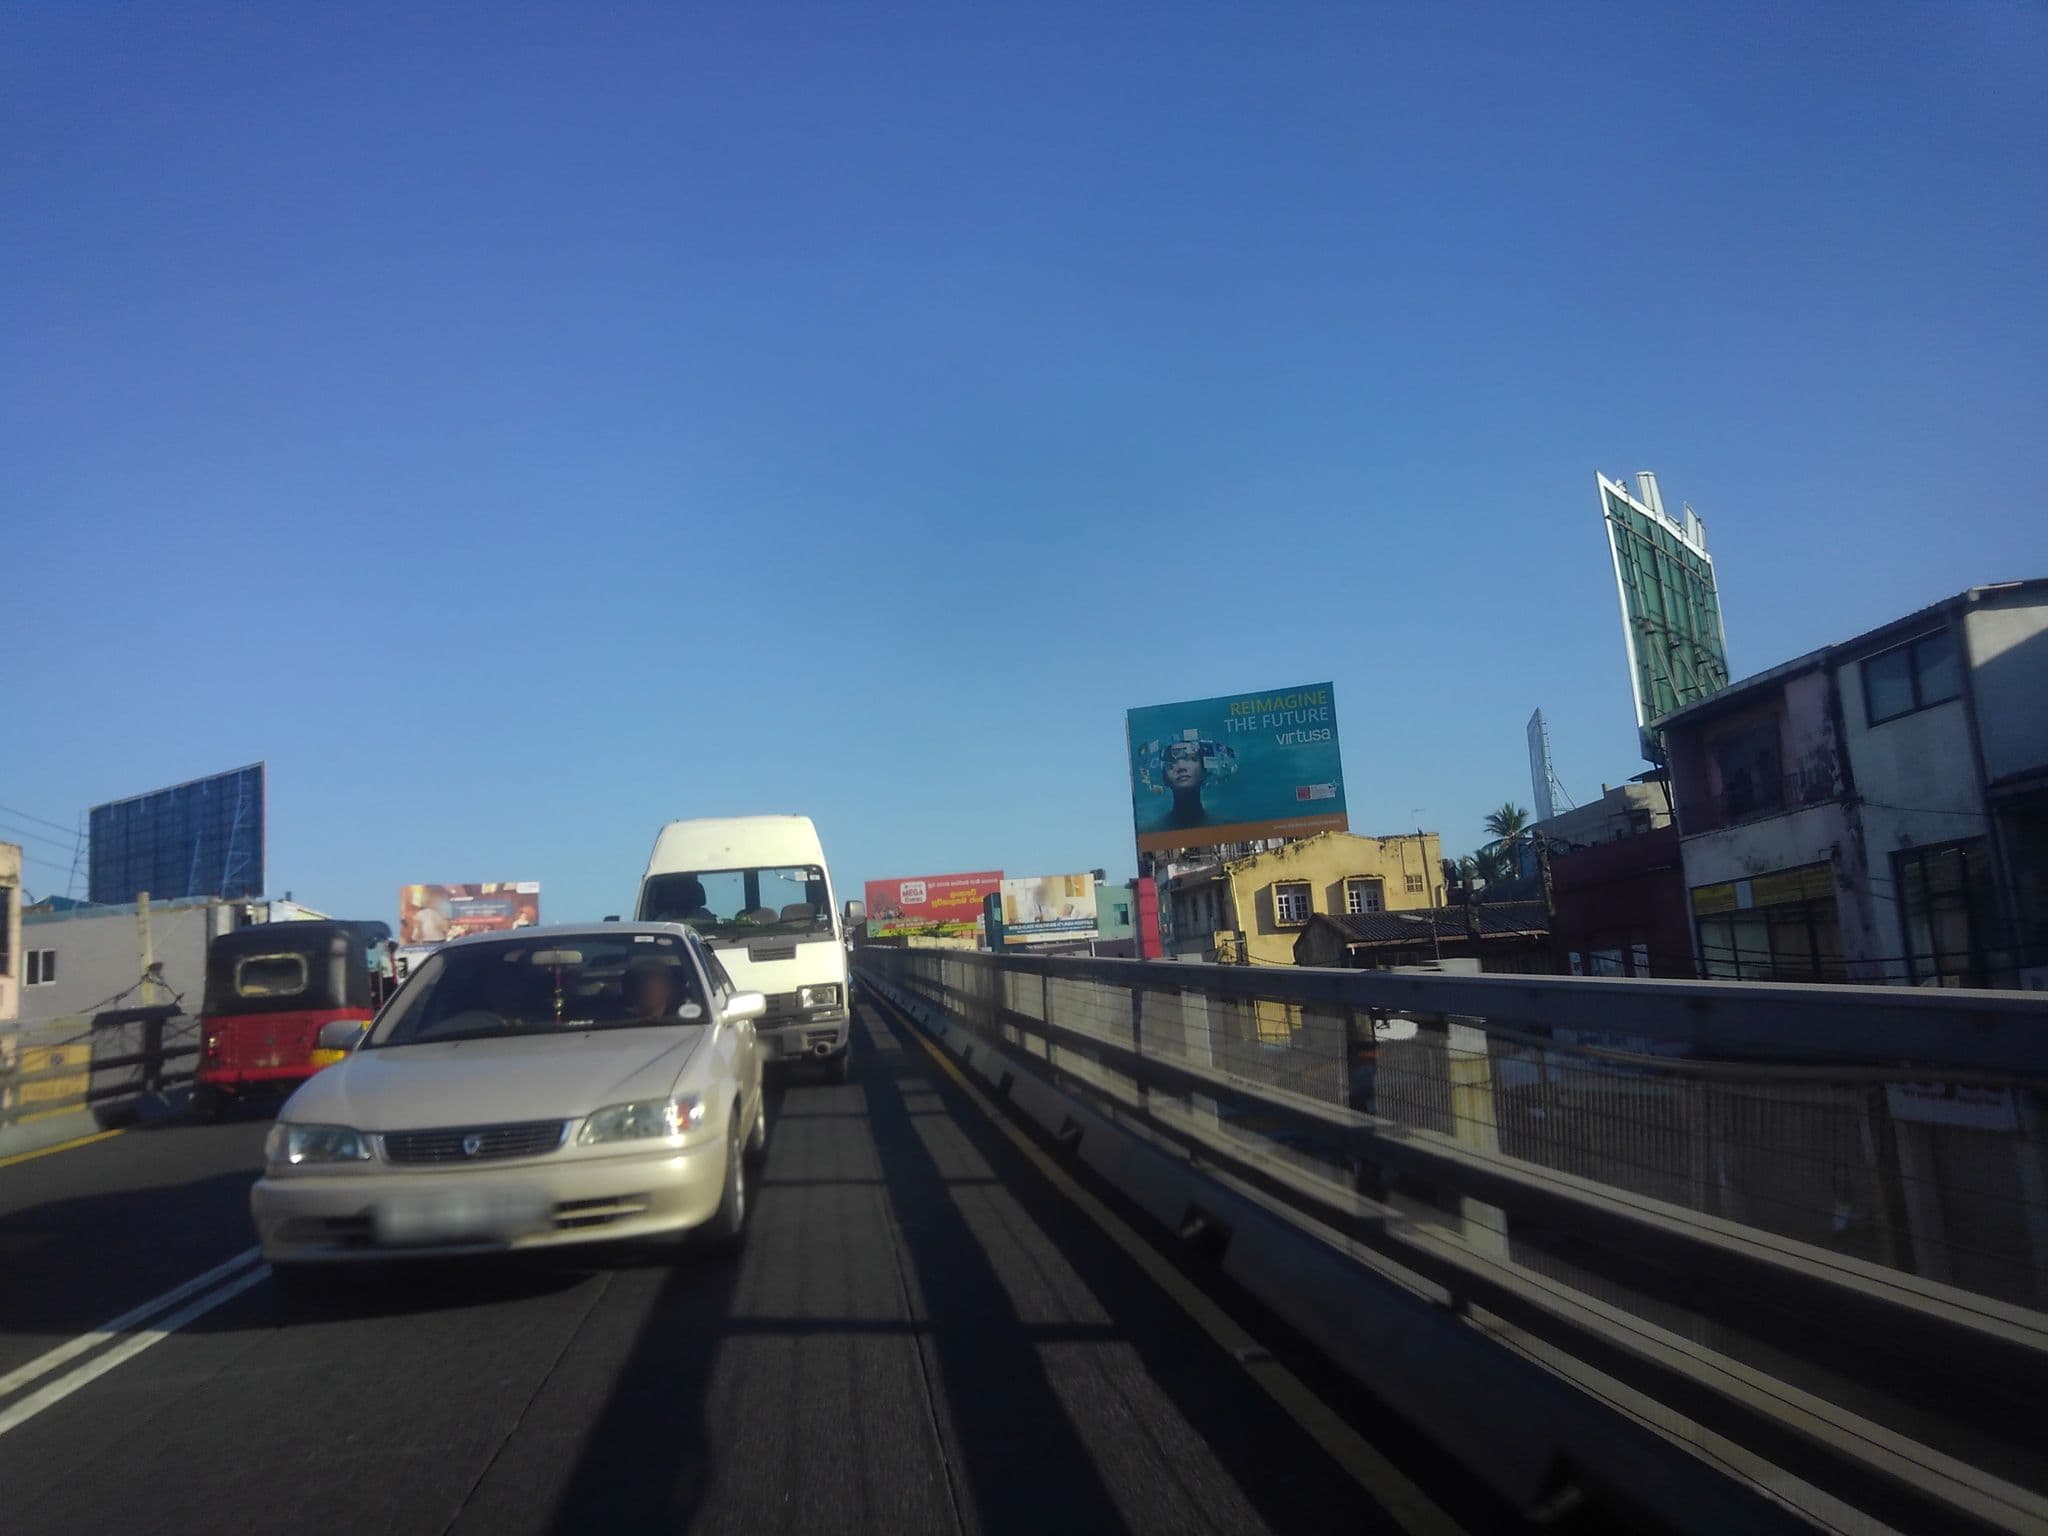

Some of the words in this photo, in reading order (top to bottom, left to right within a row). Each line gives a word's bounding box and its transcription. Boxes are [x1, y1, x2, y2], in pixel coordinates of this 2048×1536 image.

[1230, 690, 1328, 716] REIMAGINE
[1224, 715, 1257, 733] THE
[1262, 706, 1329, 729] FUTURE
[1275, 728, 1332, 745] virtusa
[902, 888, 924, 897] MEGA
